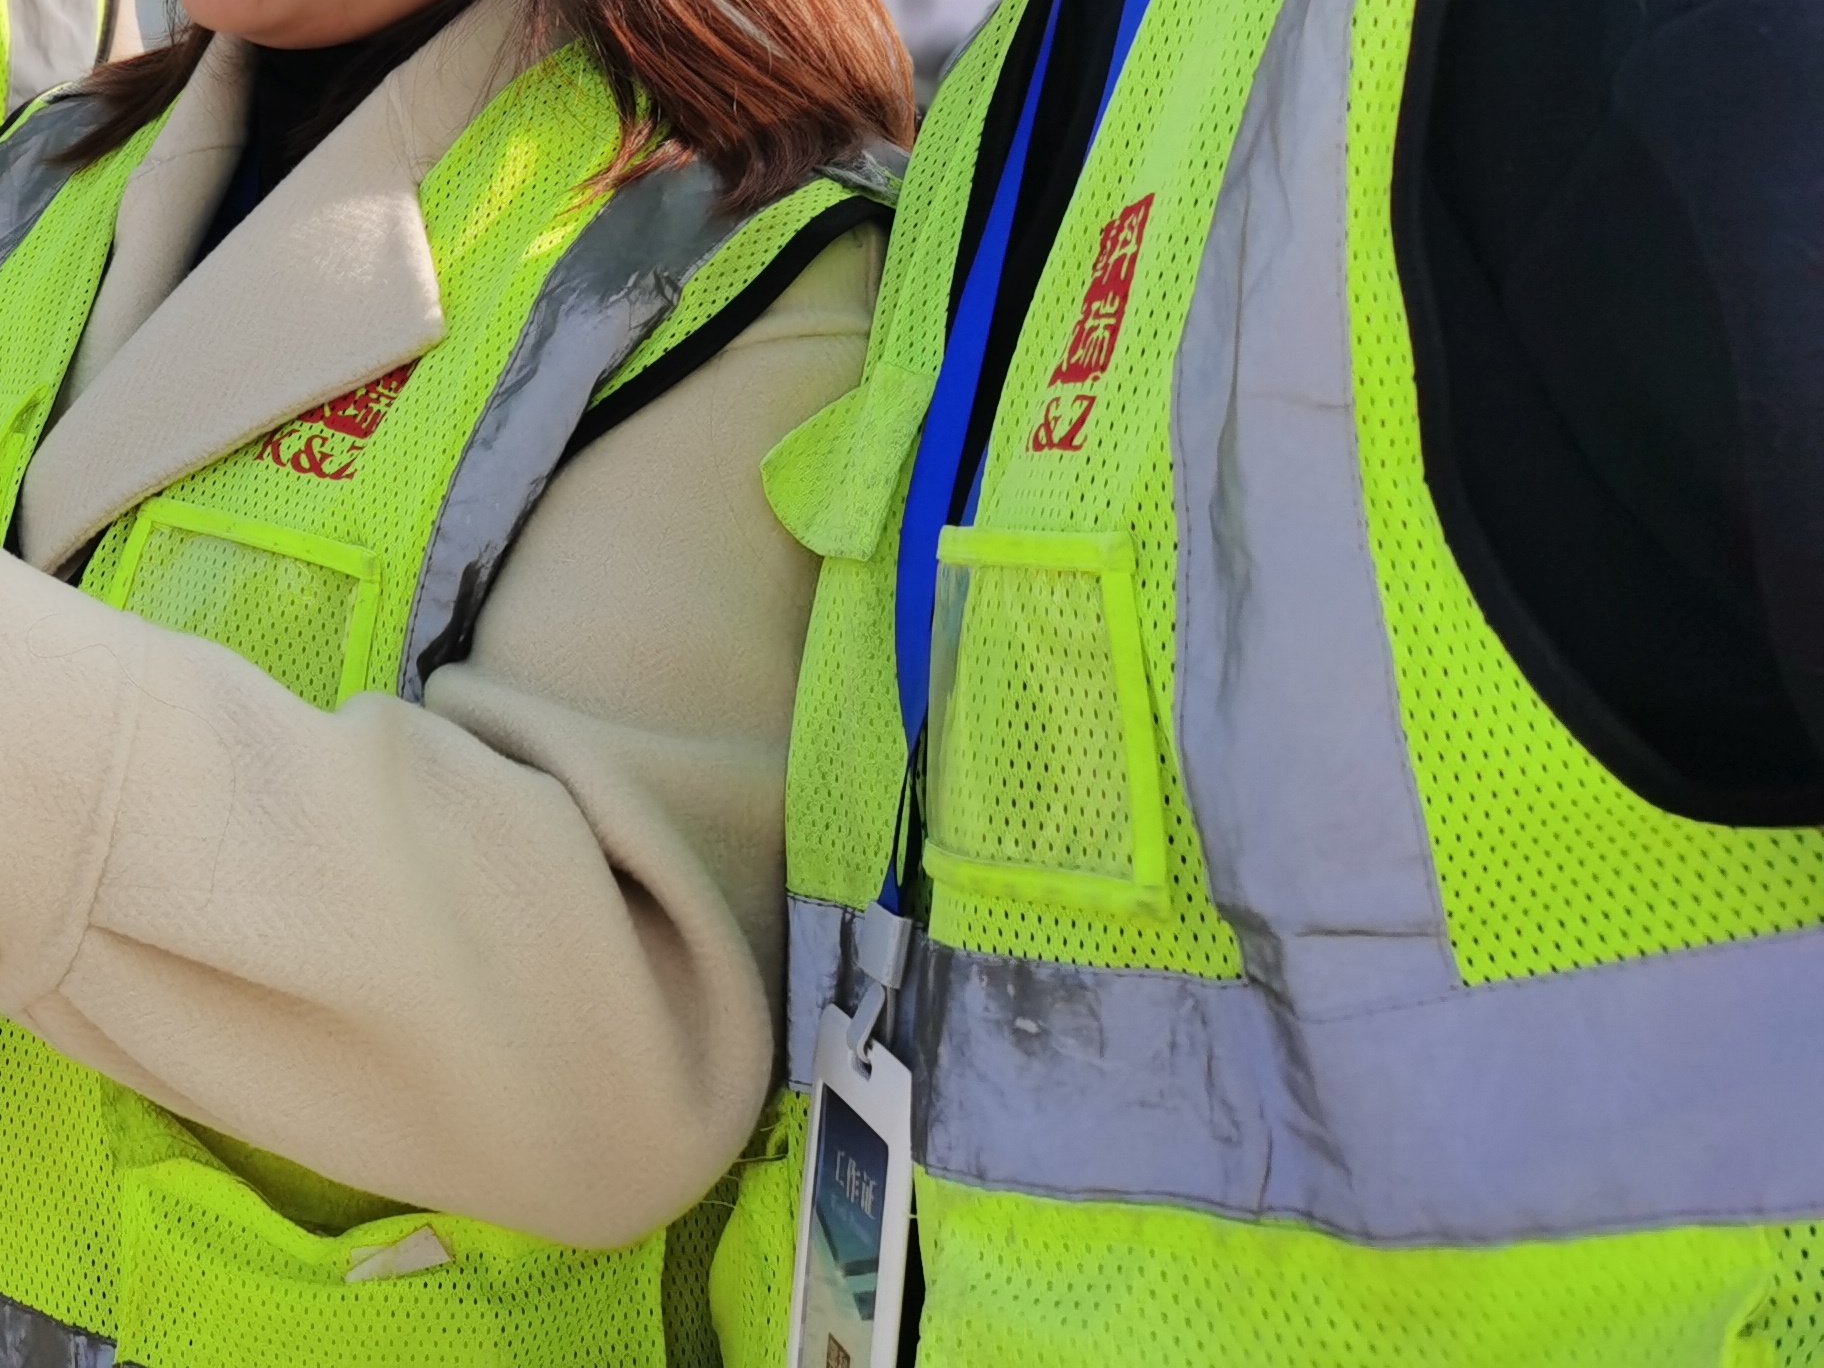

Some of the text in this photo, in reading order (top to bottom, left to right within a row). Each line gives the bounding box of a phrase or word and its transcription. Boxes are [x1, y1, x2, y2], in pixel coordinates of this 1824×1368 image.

[1027, 394, 1098, 453] &Z
[834, 1149, 876, 1220] 工作证
